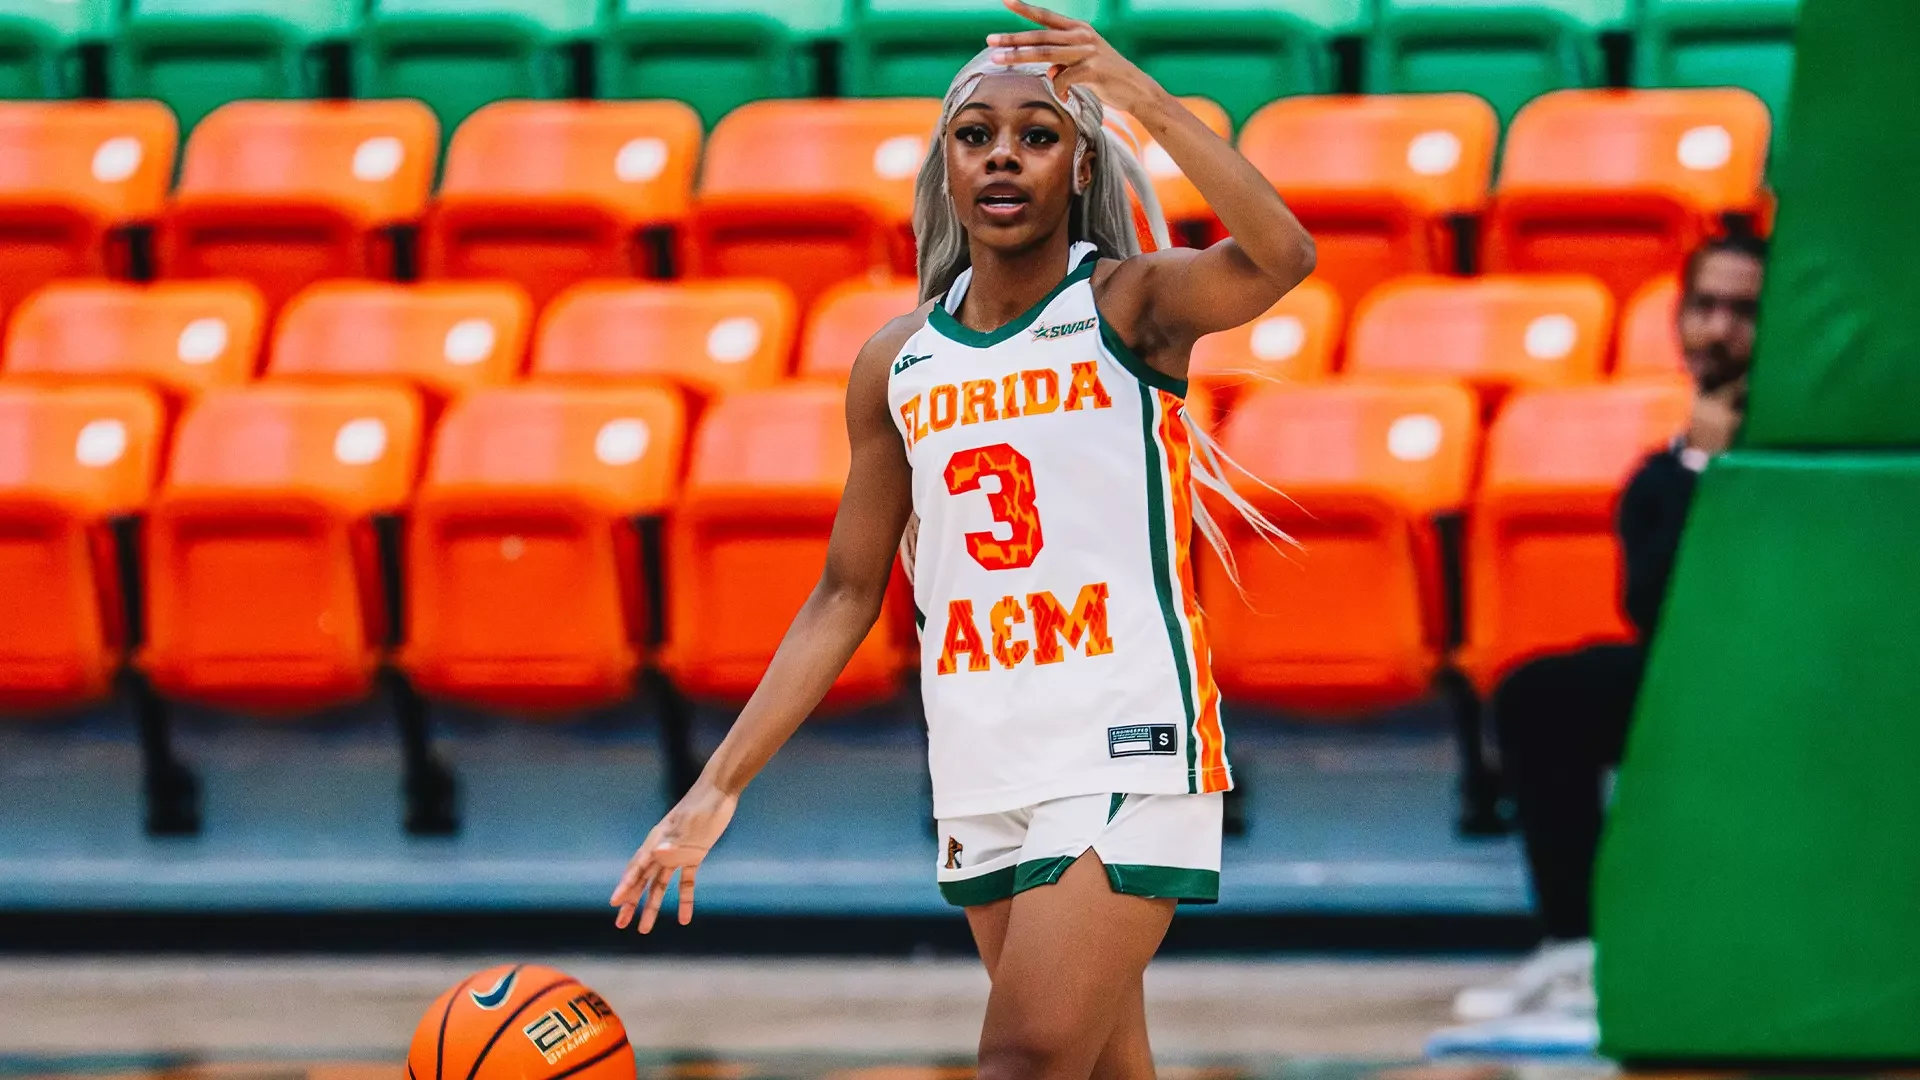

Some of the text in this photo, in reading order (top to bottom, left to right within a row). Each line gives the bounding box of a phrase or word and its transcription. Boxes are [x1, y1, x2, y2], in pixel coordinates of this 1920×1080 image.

[1049, 316, 1097, 339] SWAC
[899, 360, 1113, 452] FLORIDA
[943, 442, 1044, 571] 3
[937, 582, 1114, 676] A&M
[1158, 732, 1169, 746] S
